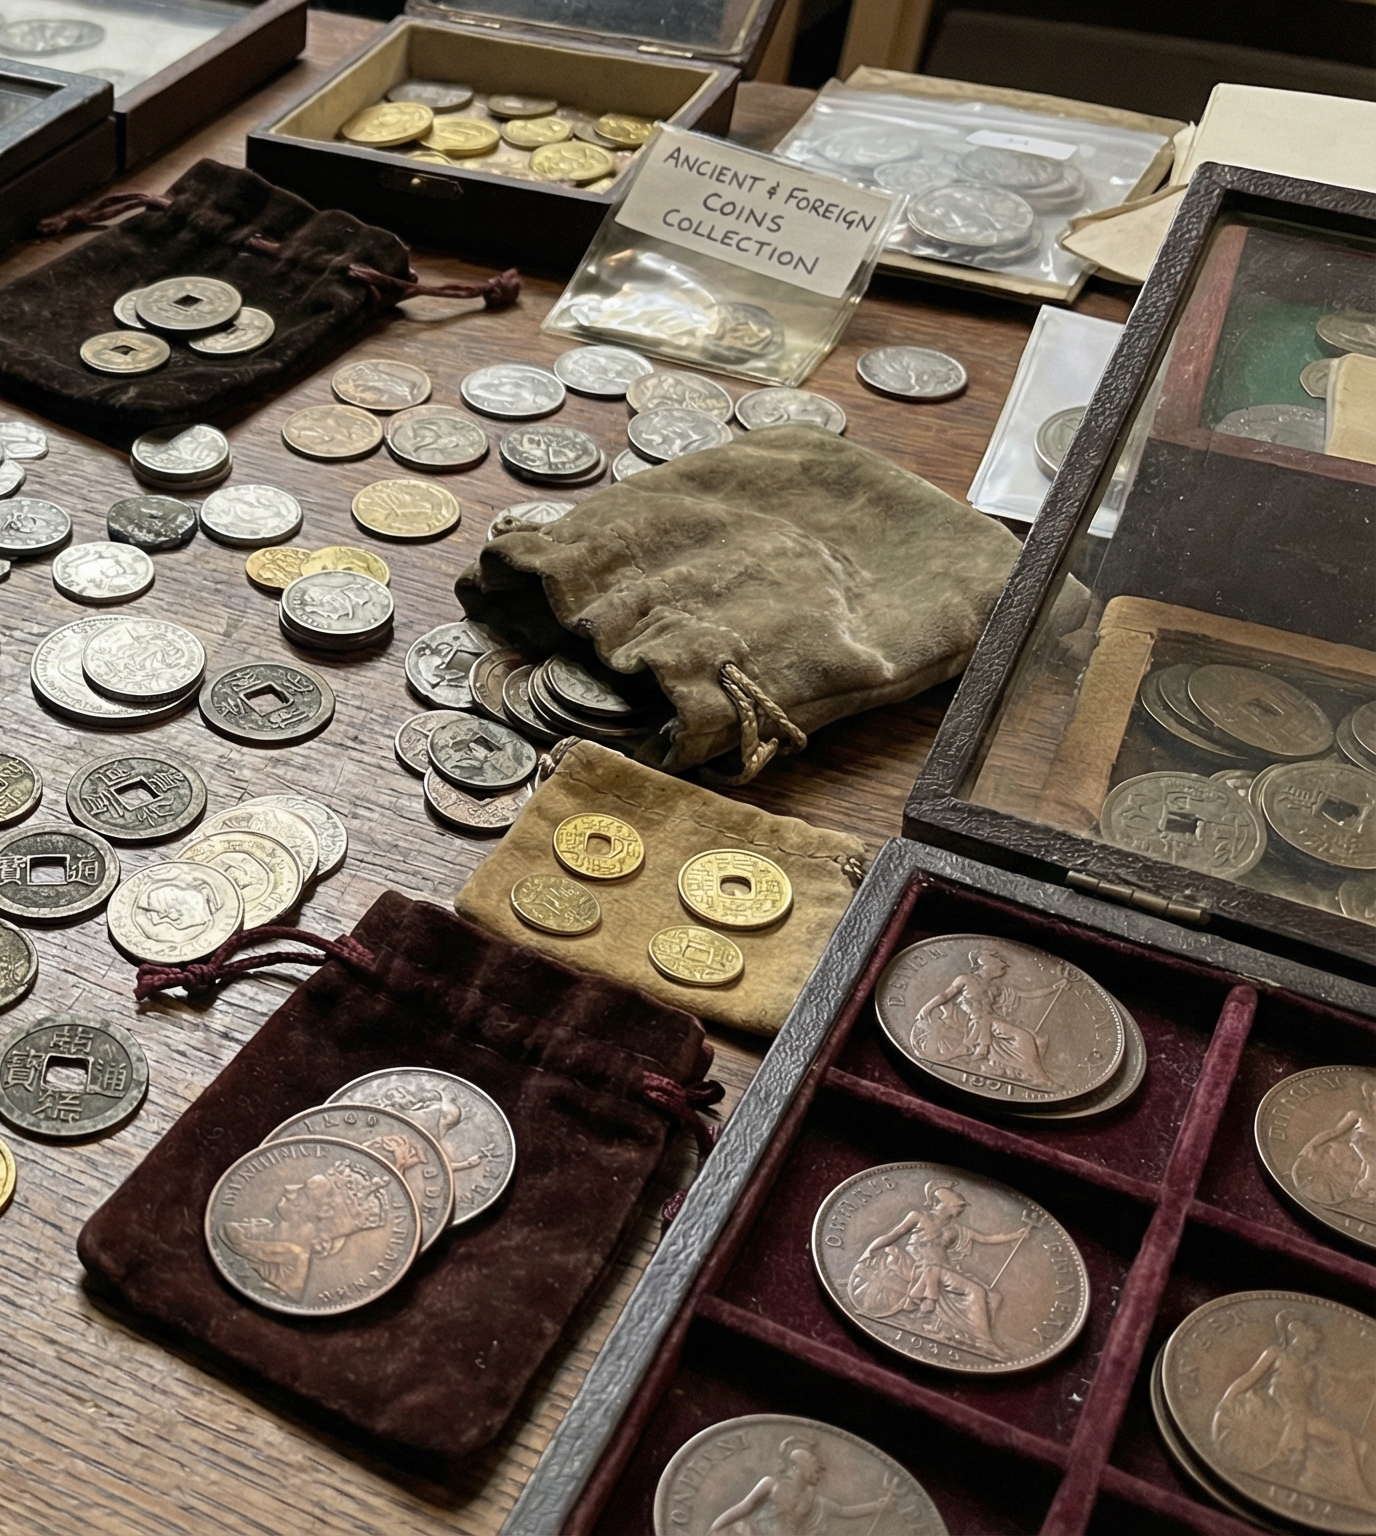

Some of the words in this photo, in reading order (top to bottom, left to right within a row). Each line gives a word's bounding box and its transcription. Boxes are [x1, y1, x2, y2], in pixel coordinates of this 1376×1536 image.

[663, 146, 765, 194] ANCIENT
[766, 180, 780, 200] &
[784, 188, 877, 233] FOREIGN
[702, 193, 784, 233] COINS
[662, 208, 820, 275] COLLECTION
